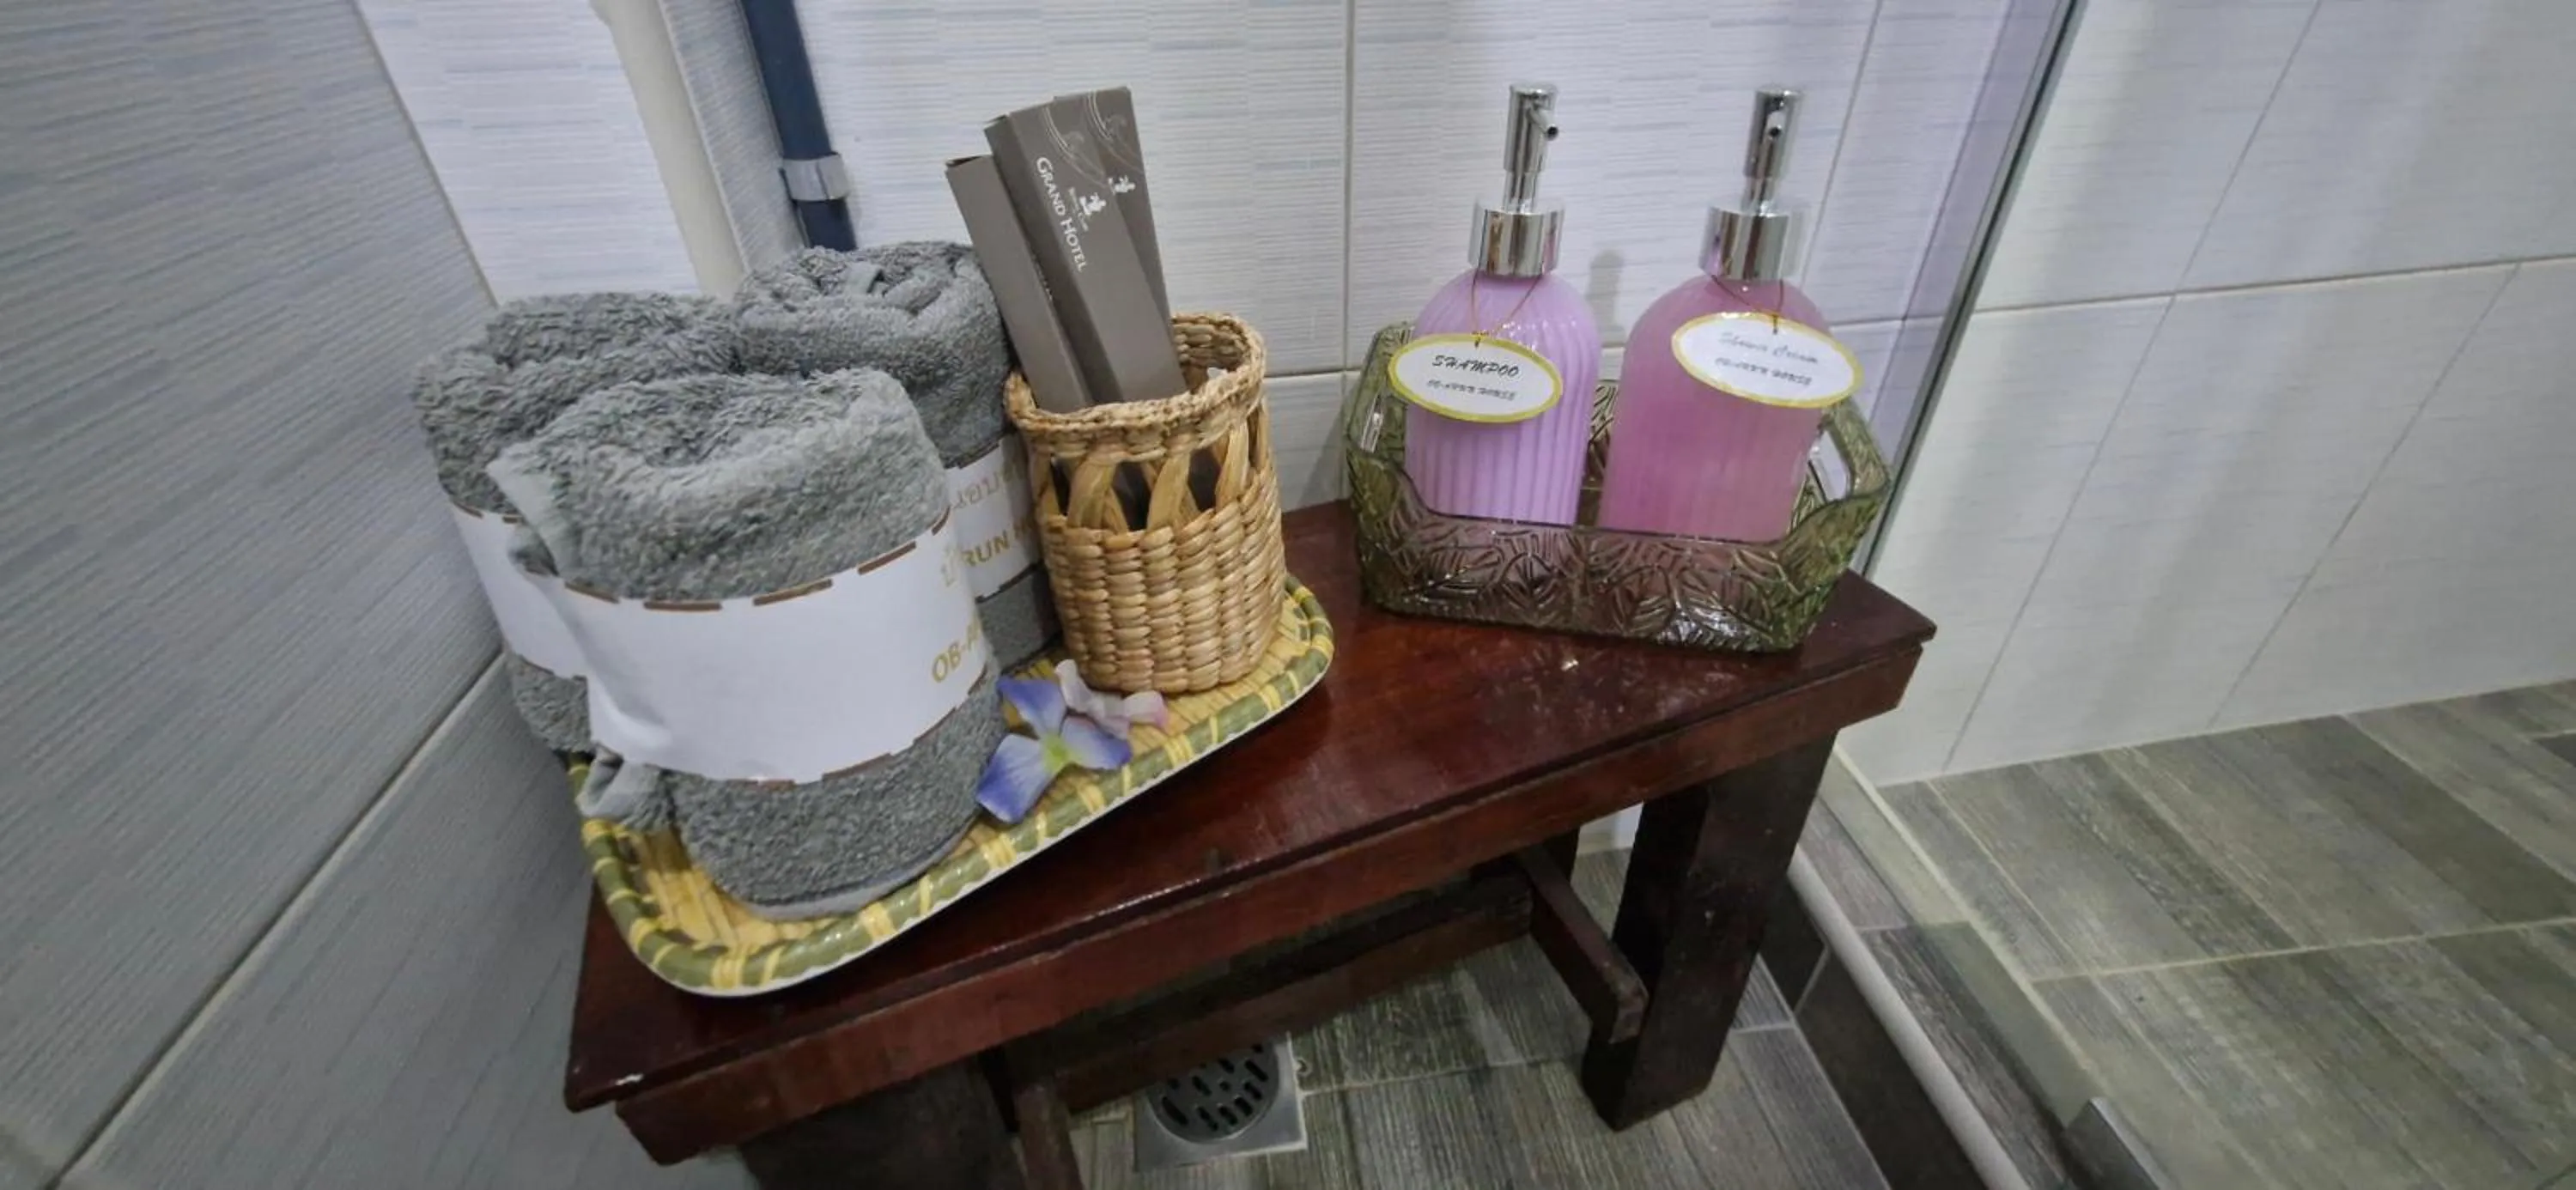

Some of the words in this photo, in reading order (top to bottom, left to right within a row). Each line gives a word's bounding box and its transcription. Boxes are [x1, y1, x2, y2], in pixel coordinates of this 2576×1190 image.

[1036, 157, 1066, 216] GRAND
[1060, 216, 1087, 272] HOTEL
[1432, 355, 1520, 377] SHAMPOO
